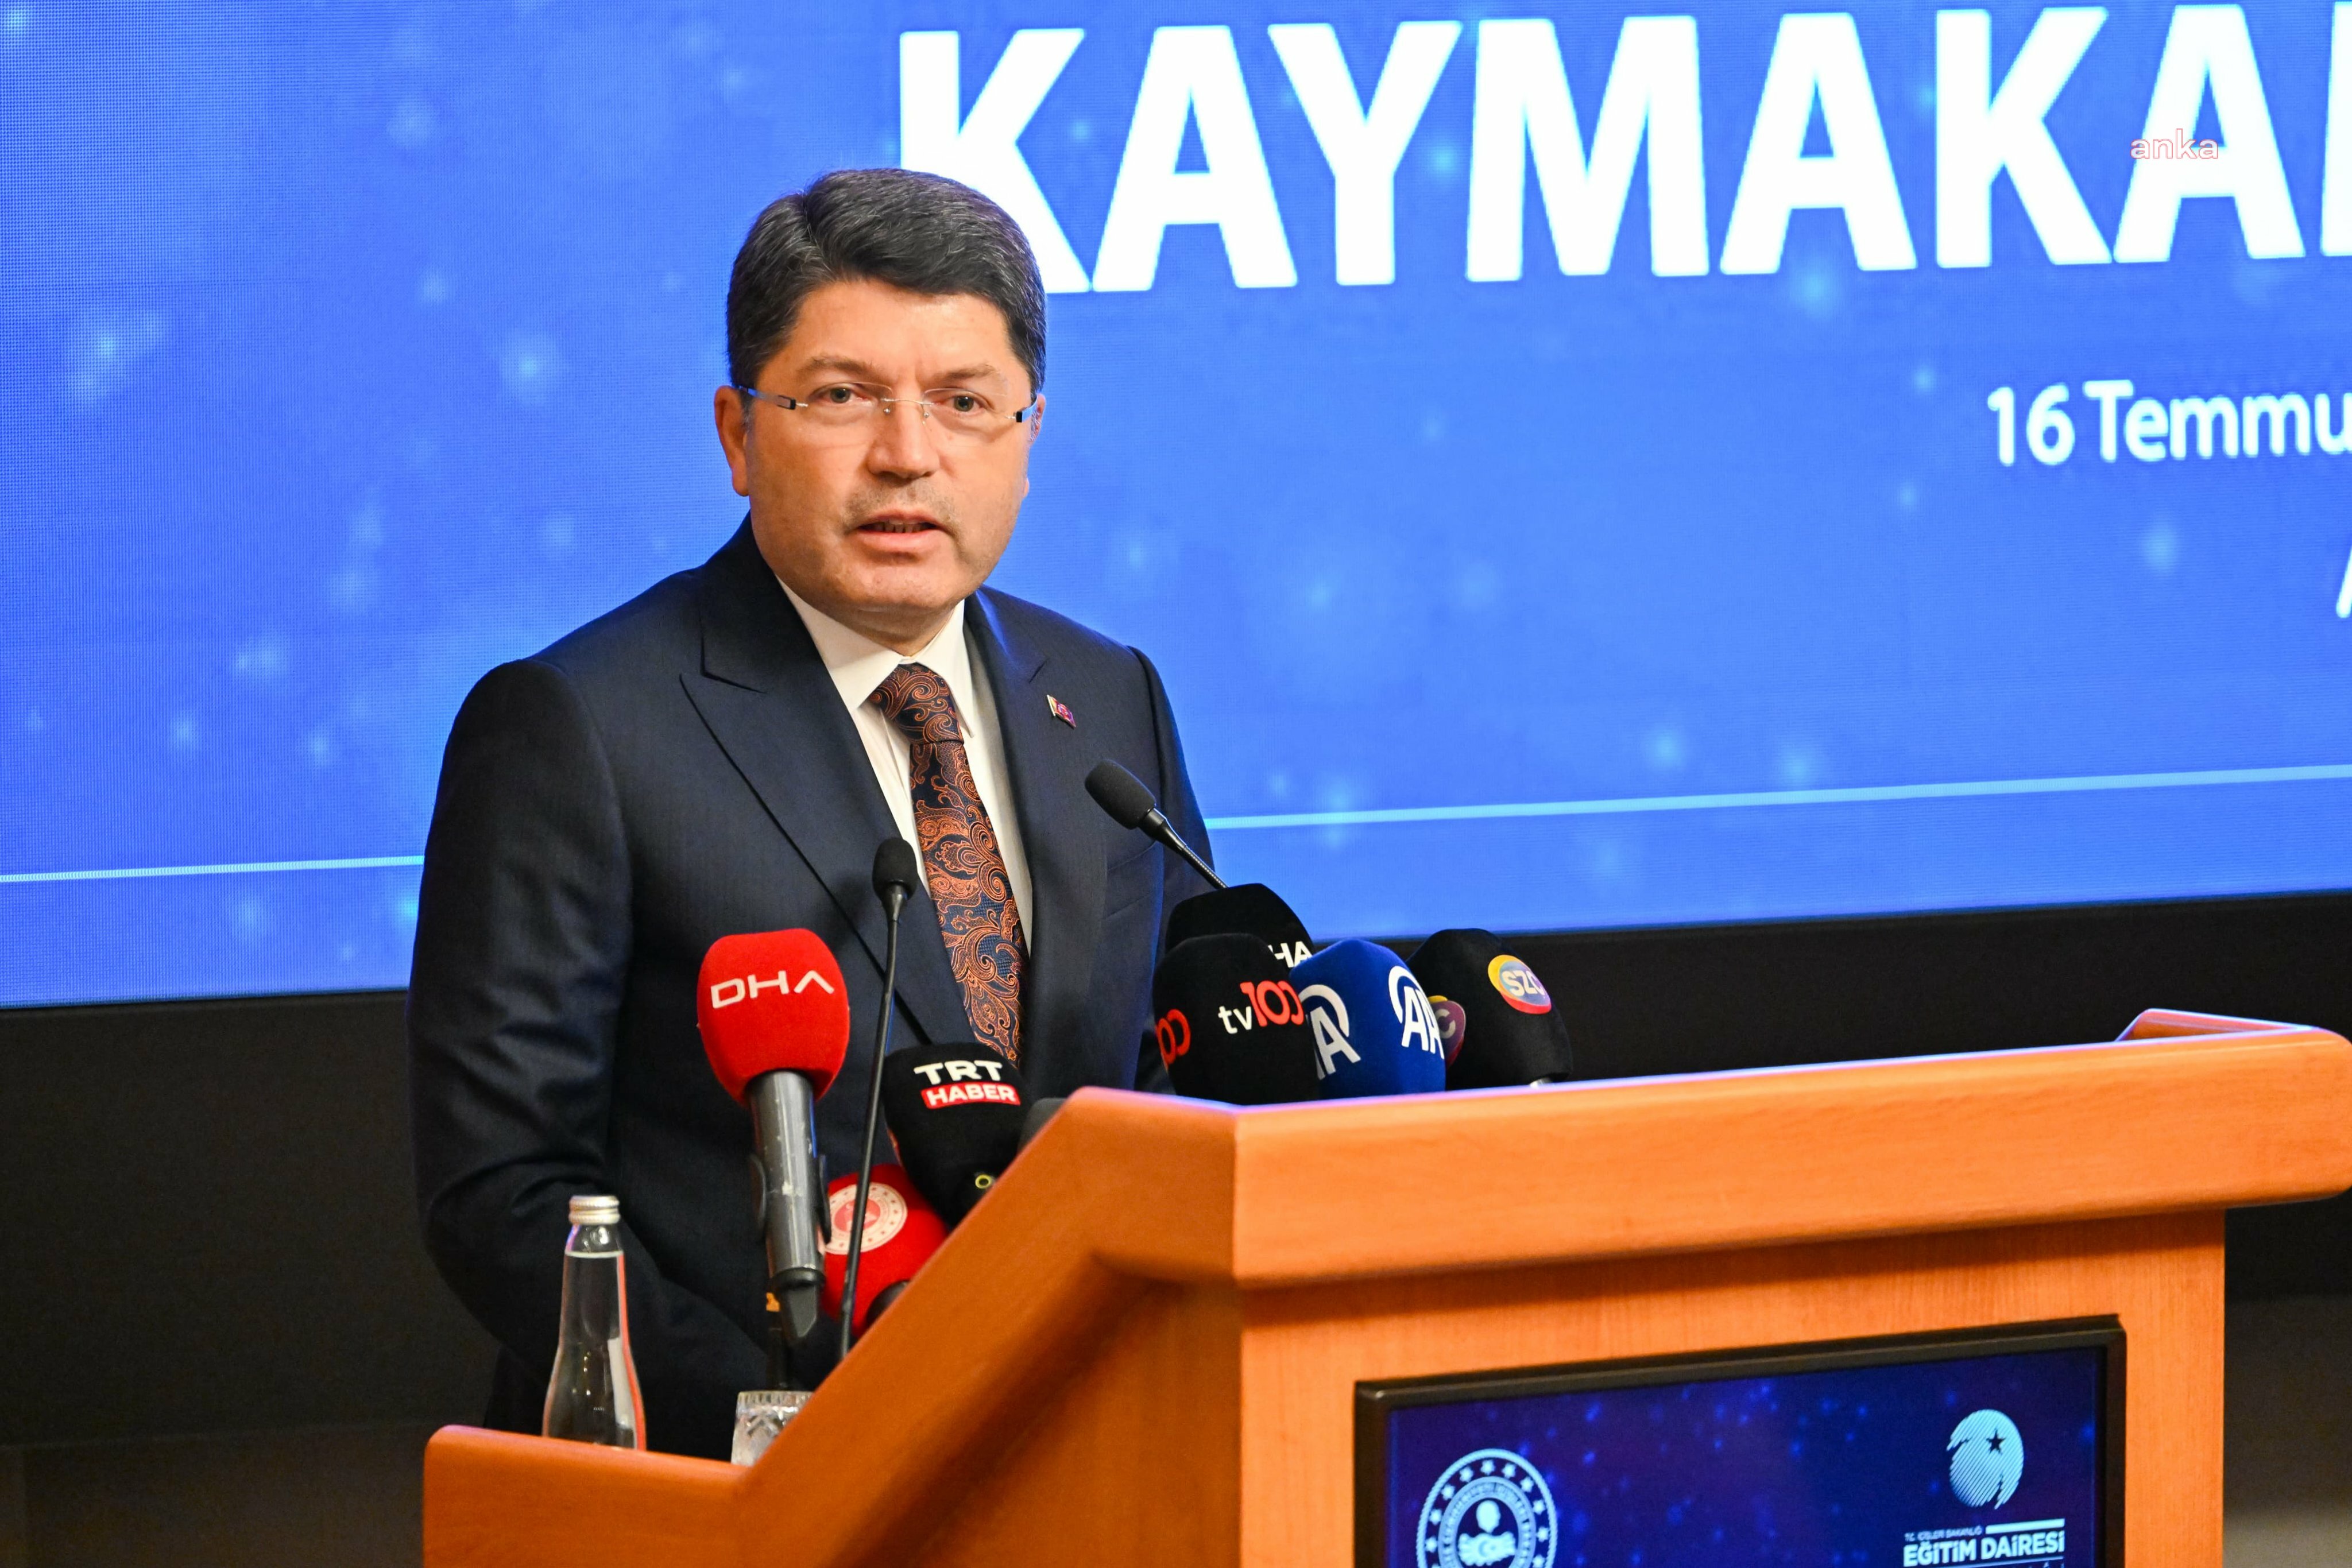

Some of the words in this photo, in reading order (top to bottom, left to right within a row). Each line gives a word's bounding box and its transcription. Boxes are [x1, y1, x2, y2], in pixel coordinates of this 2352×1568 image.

[1988, 383, 2075, 466] 16
[2083, 380, 2352, 463] Temmu
[711, 970, 834, 1009] DHA
[1501, 970, 1546, 997] SZC
[1218, 981, 1304, 1034] tv100
[1155, 1009, 1191, 1074] 00
[1306, 1006, 1361, 1080] A
[914, 1060, 1003, 1085] TRT
[926, 1083, 1016, 1106] HABER
[1904, 1539, 1976, 1567] EĞİTİM
[1981, 1530, 2065, 1559] DAİRESİ
